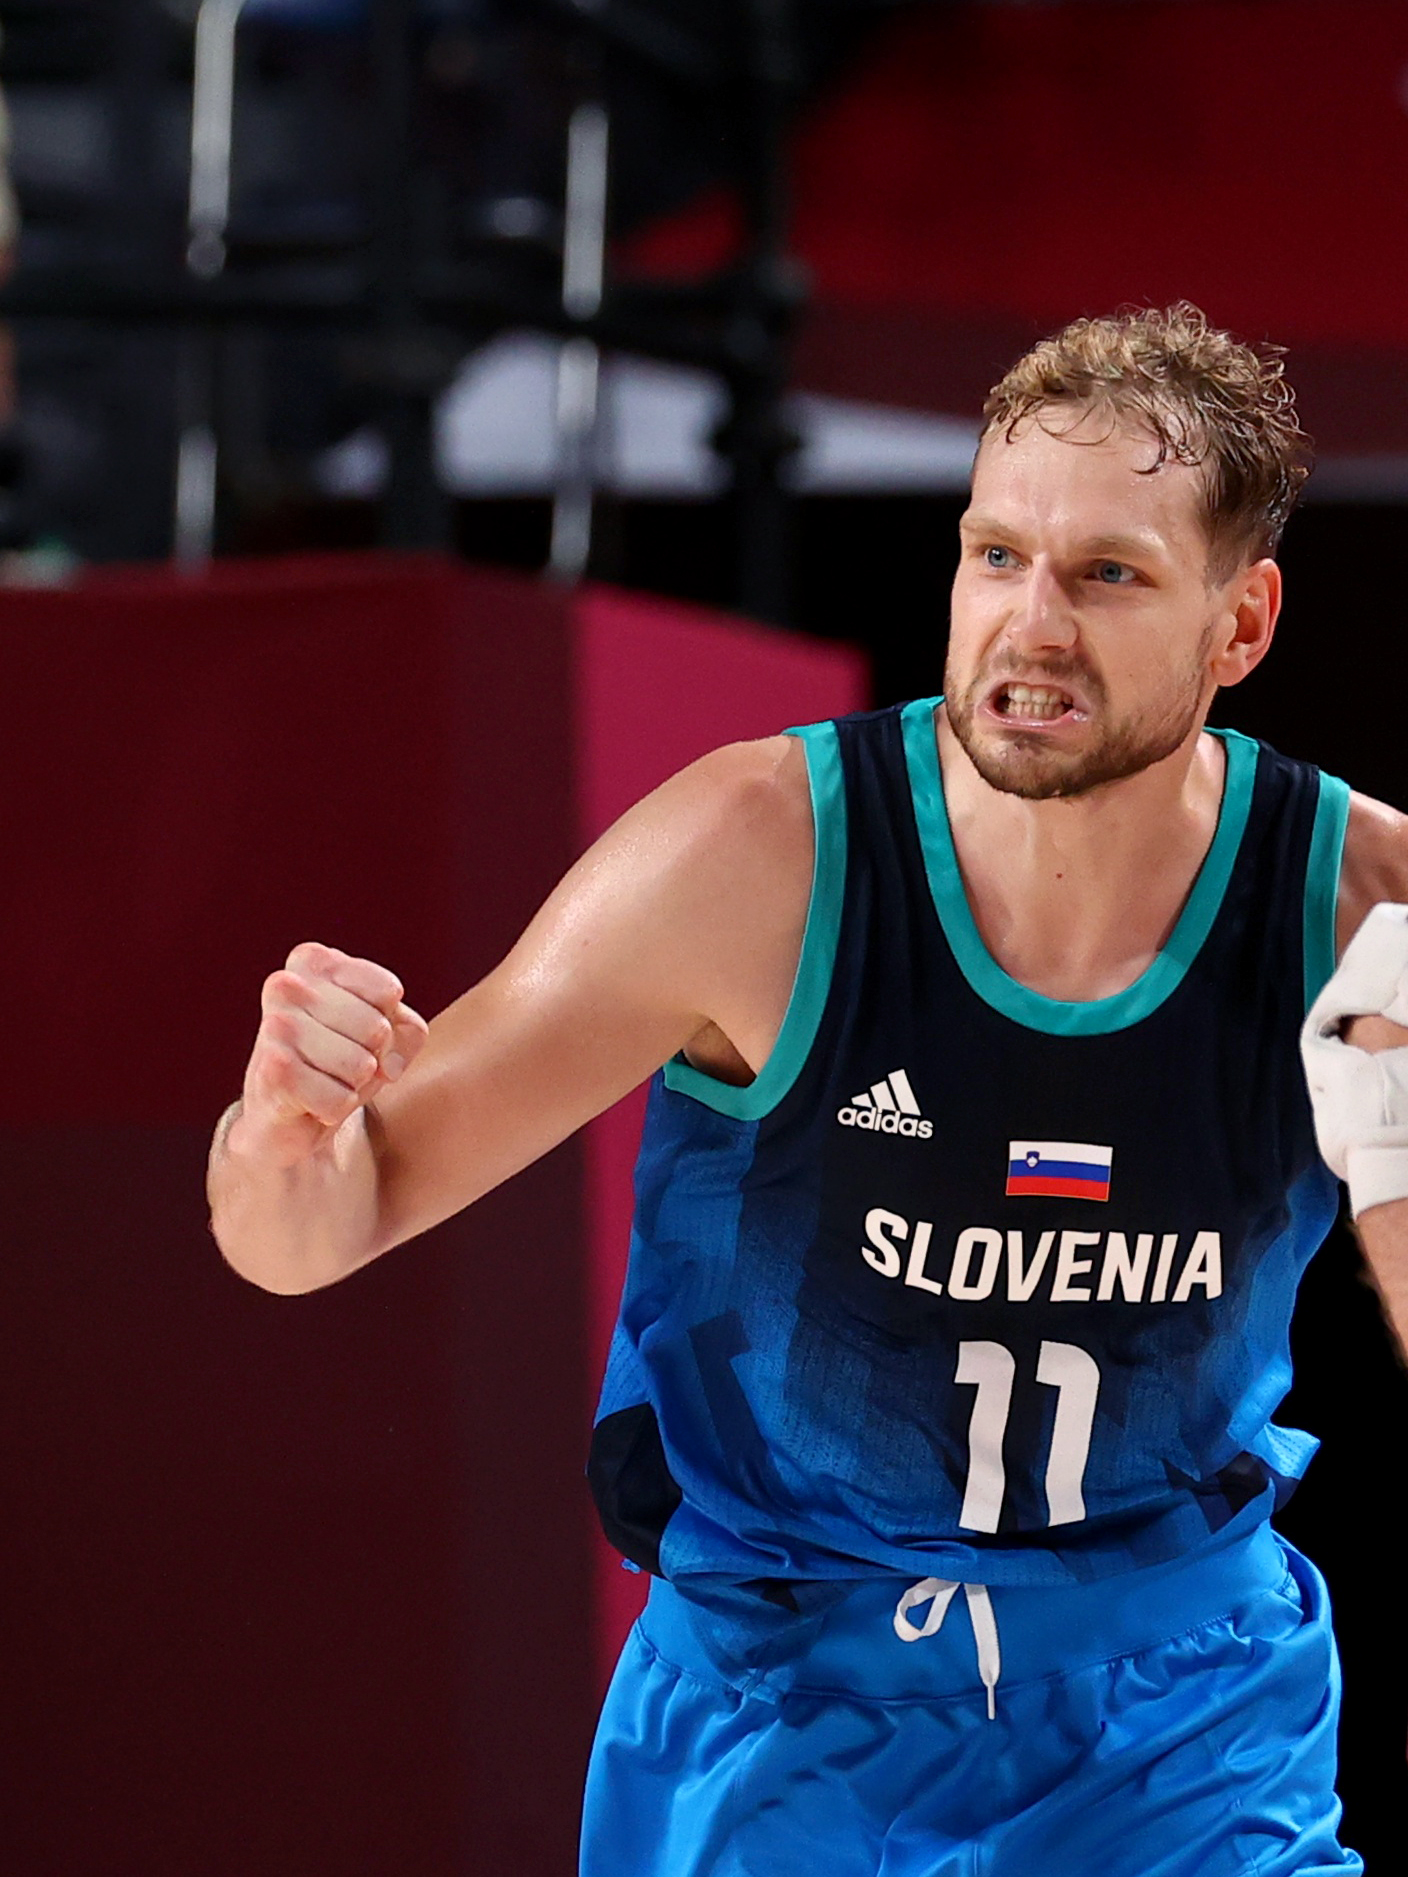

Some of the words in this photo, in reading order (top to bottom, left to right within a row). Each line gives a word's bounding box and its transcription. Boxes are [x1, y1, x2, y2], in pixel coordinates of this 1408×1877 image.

[836, 1105, 934, 1139] adidas
[861, 1208, 1223, 1303] SLOVENIA
[954, 1340, 1100, 1534] 11
